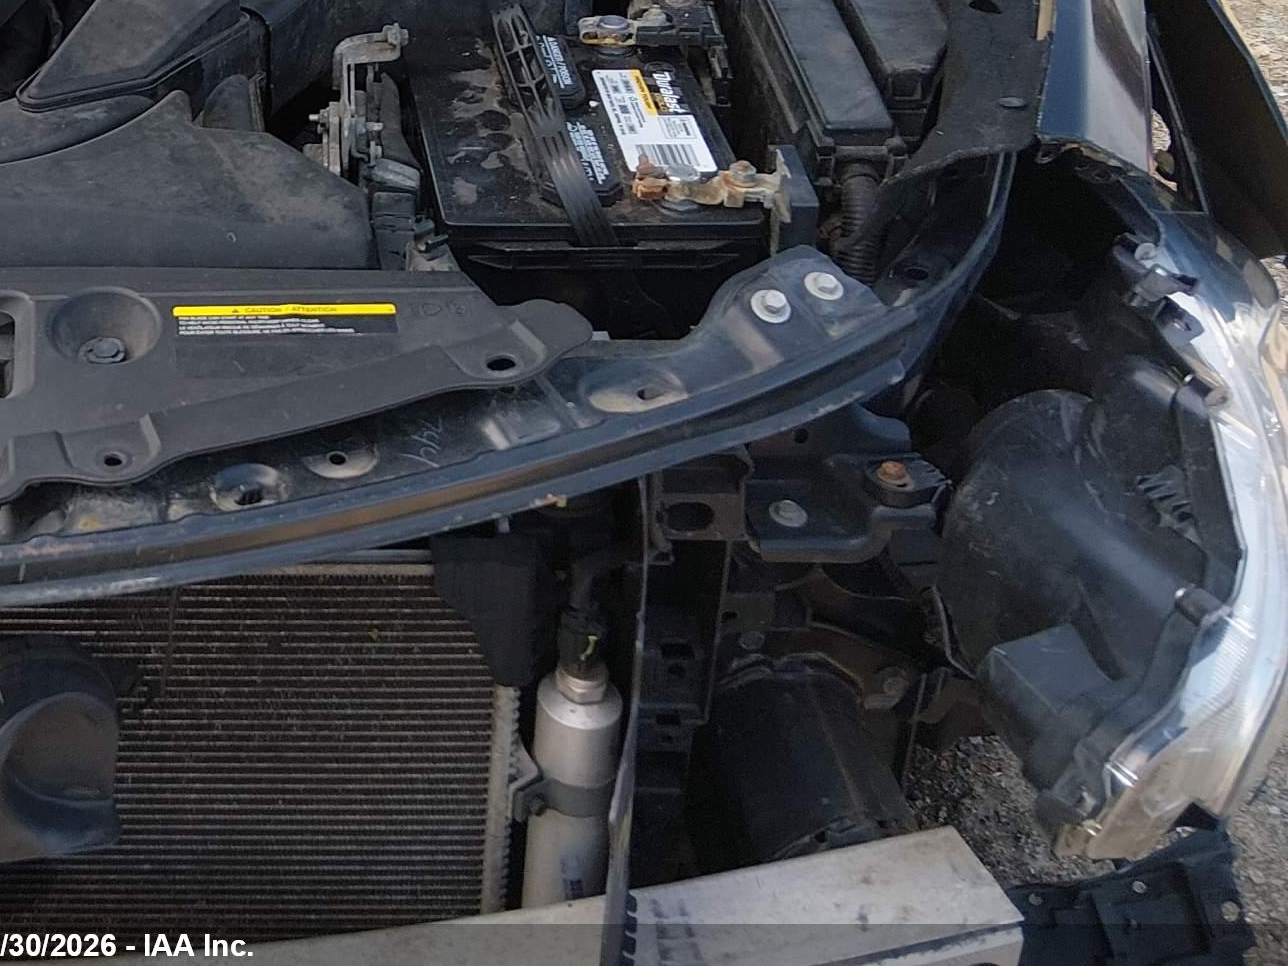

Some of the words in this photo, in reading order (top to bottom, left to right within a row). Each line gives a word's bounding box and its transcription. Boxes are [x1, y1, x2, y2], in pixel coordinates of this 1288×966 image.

[652, 71, 688, 114] Duralast
[244, 306, 283, 314] CAUTION
[291, 305, 337, 313] ATTENTION
